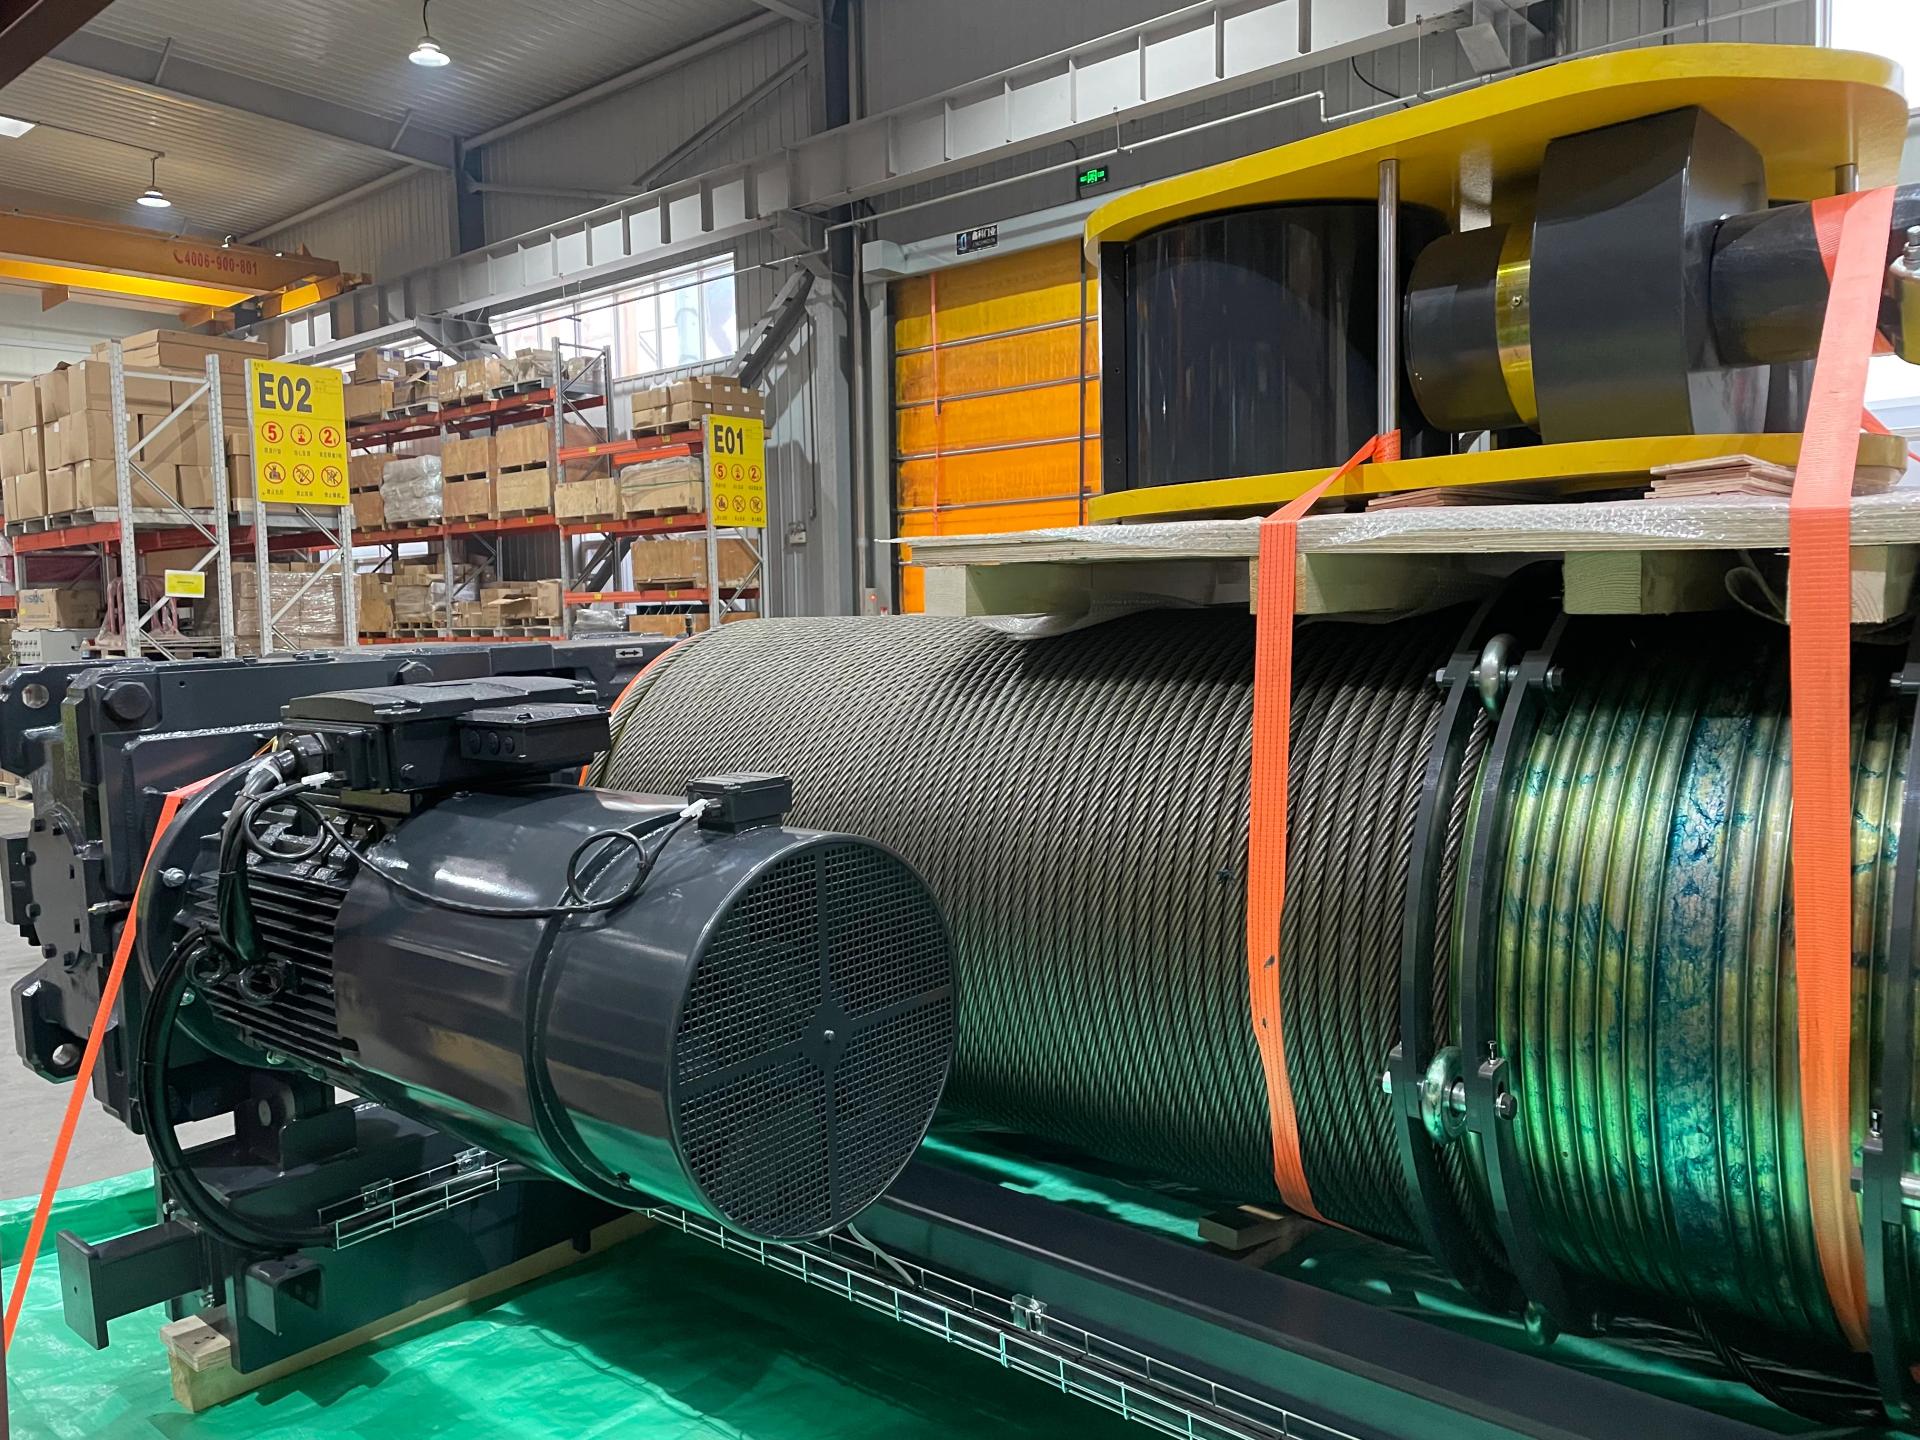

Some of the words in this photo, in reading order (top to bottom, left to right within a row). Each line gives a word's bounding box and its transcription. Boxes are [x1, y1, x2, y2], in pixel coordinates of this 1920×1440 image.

[184, 250, 257, 276] 4006-900-801
[258, 372, 313, 413] E02
[268, 424, 277, 441] 5
[713, 424, 744, 456] E01
[717, 465, 724, 478] 5
